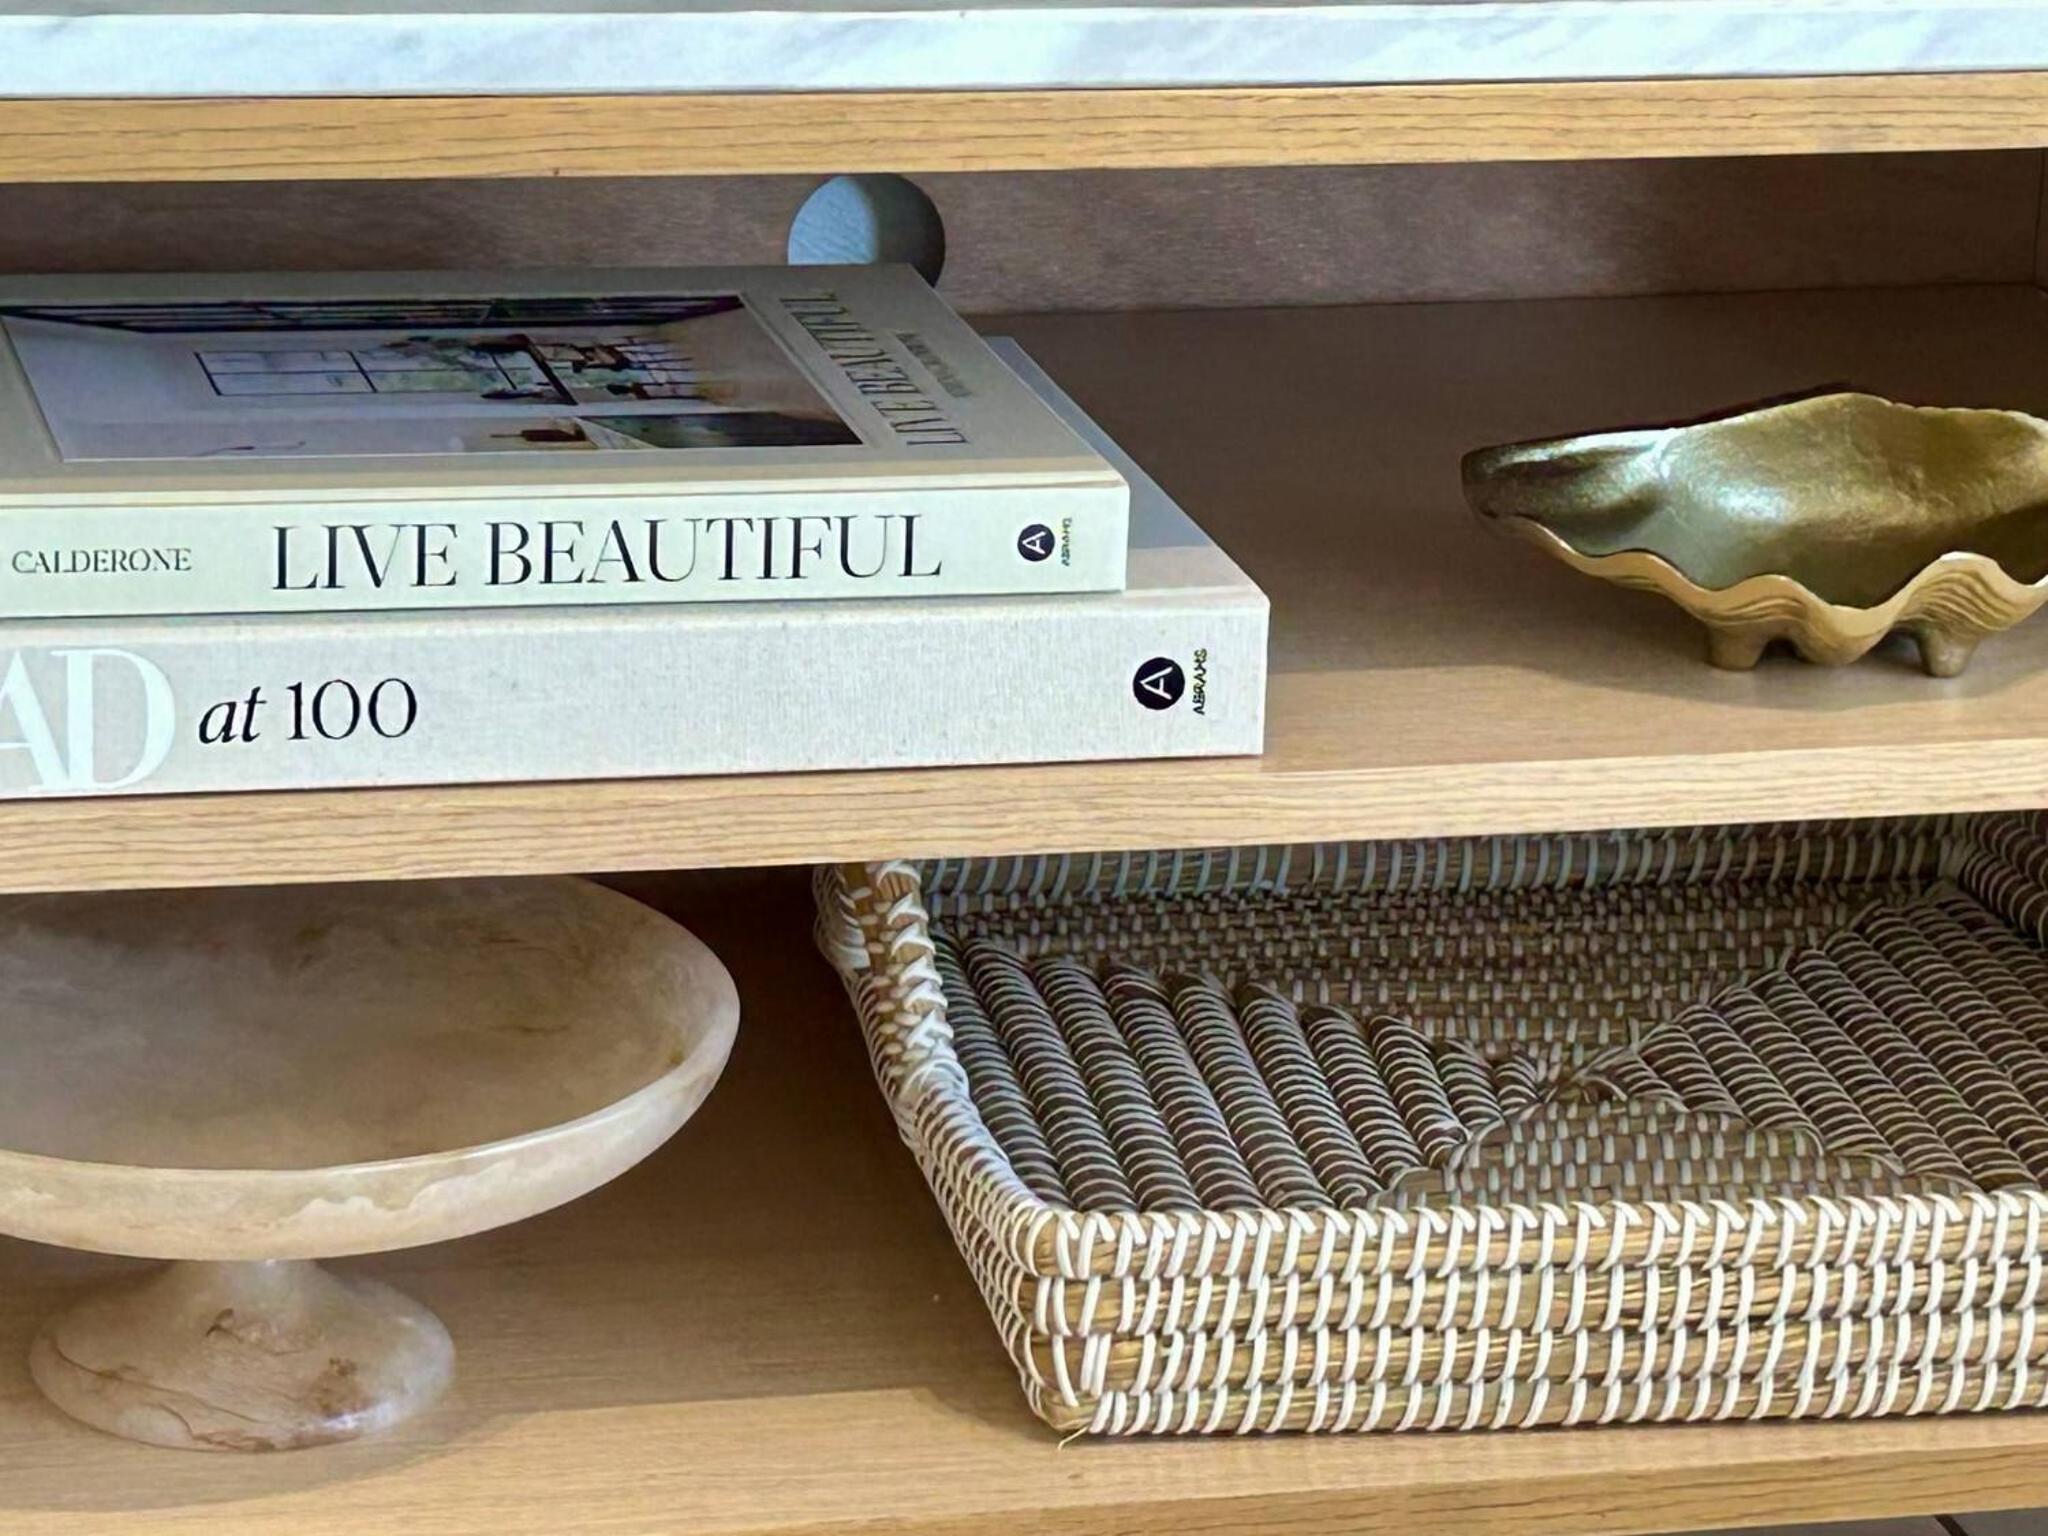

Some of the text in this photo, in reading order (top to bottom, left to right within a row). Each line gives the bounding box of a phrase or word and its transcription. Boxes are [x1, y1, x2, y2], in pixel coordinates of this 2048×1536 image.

[870, 400, 968, 444] LIVE
[12, 548, 192, 573] CALDERONE
[272, 514, 943, 590] LIVE BEAUTIFUL
[0, 648, 418, 791] AD at 100
